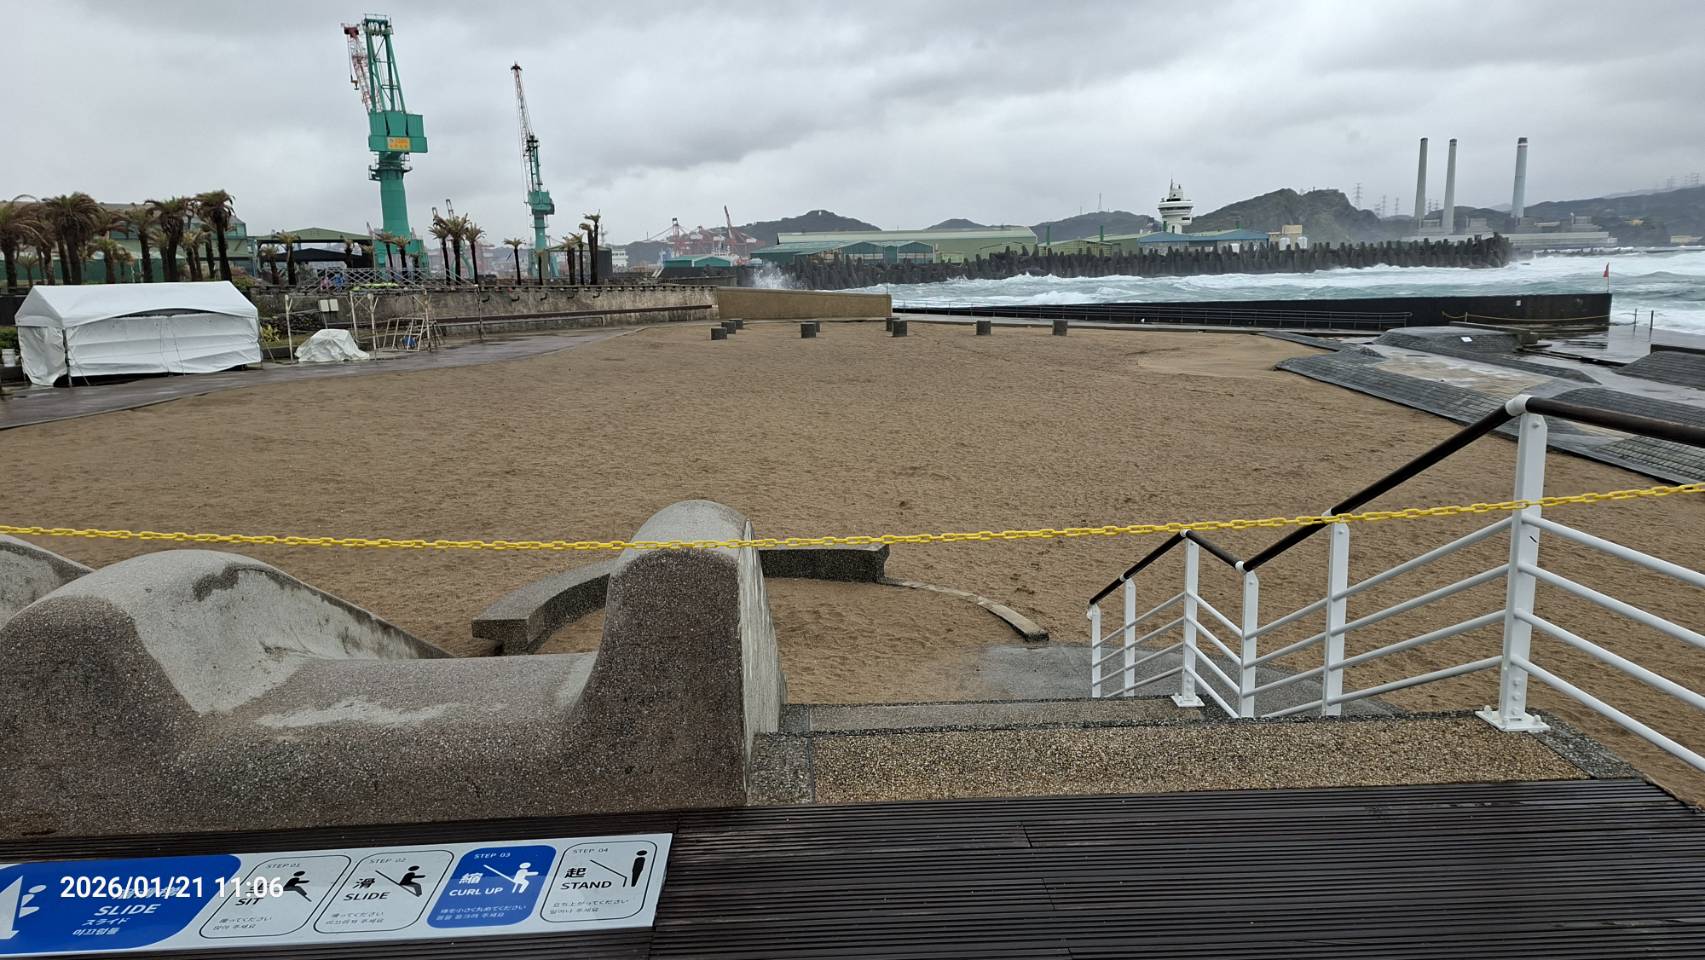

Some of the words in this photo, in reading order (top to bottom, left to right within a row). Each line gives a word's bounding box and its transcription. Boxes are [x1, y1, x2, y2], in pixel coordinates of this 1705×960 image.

[564, 867, 587, 878] 起
[459, 872, 483, 884] 縮
[352, 878, 376, 889] 滑
[560, 880, 612, 890] STAND
[343, 892, 392, 901] SLIDE
[449, 888, 481, 897] CURL
[485, 887, 504, 895] UP
[235, 897, 264, 906] SIT
[94, 904, 162, 916] SLIDE
[81, 918, 131, 926] スライド
